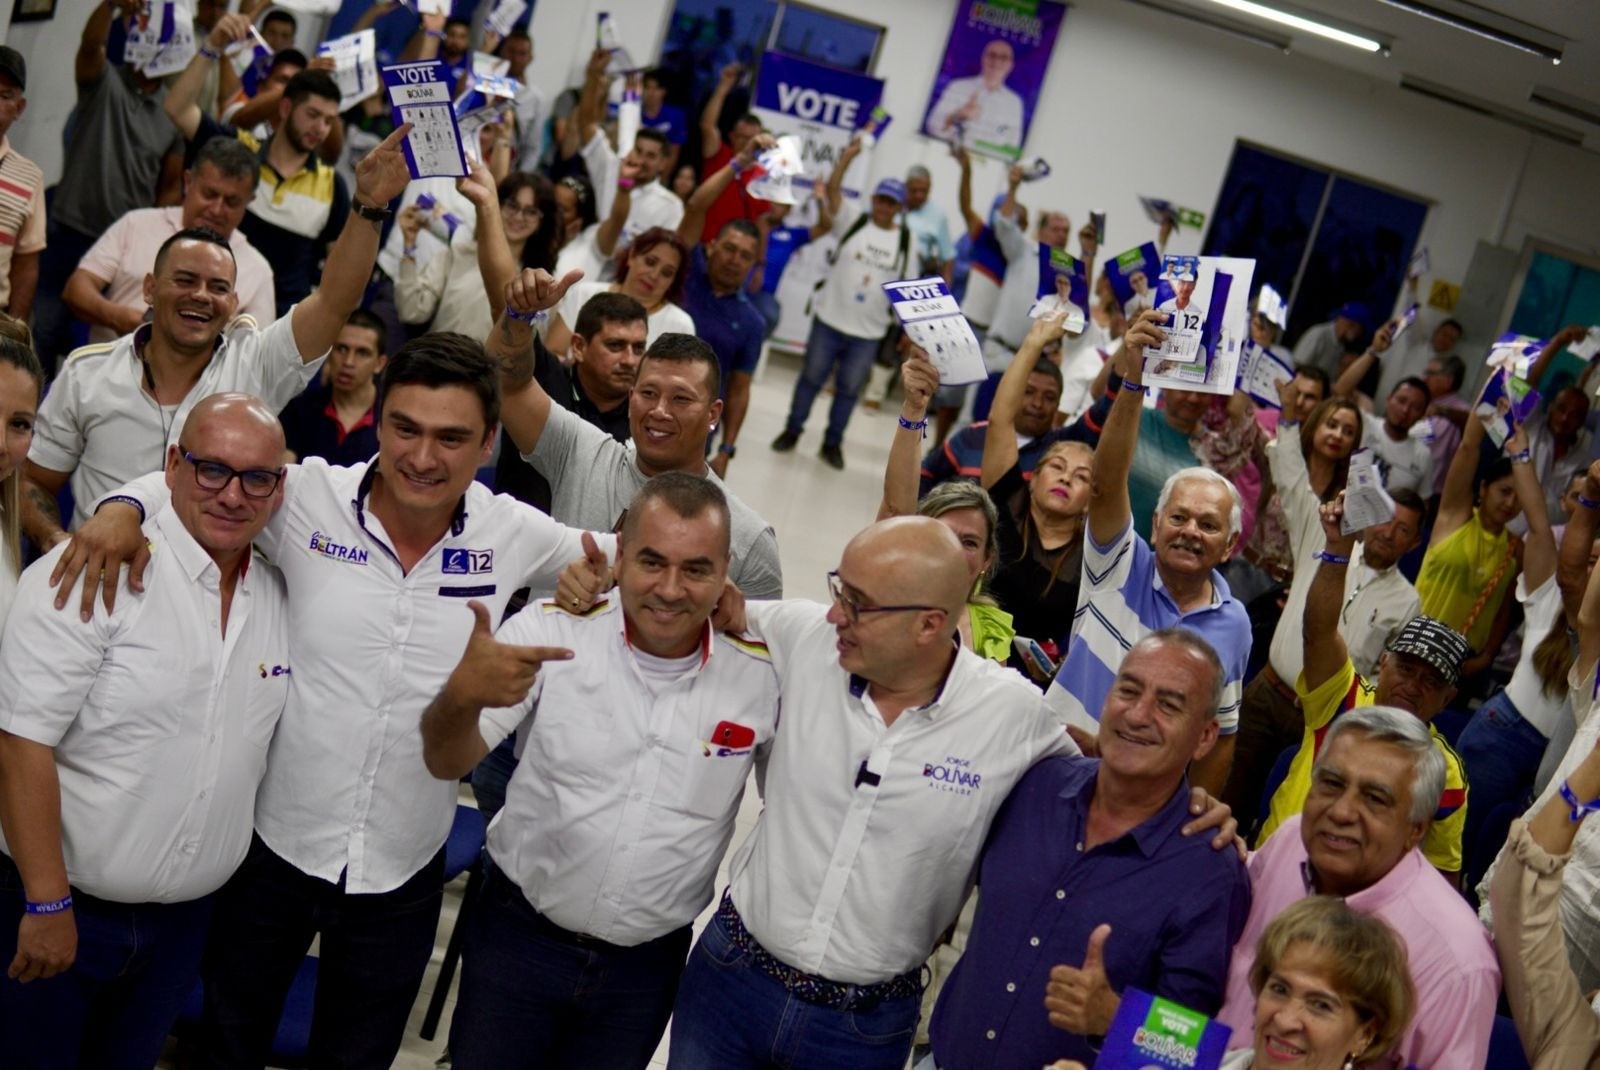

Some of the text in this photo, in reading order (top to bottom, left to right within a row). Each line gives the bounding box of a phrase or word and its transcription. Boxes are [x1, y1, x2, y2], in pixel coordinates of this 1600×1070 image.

[397, 67, 436, 83] VOTE
[777, 82, 860, 128] VOTE
[896, 284, 943, 300] VOTE
[1184, 314, 1199, 330] 12
[309, 538, 368, 562] BELTRÁN
[470, 553, 492, 571] 12
[923, 763, 981, 789] BOLÍVAR
